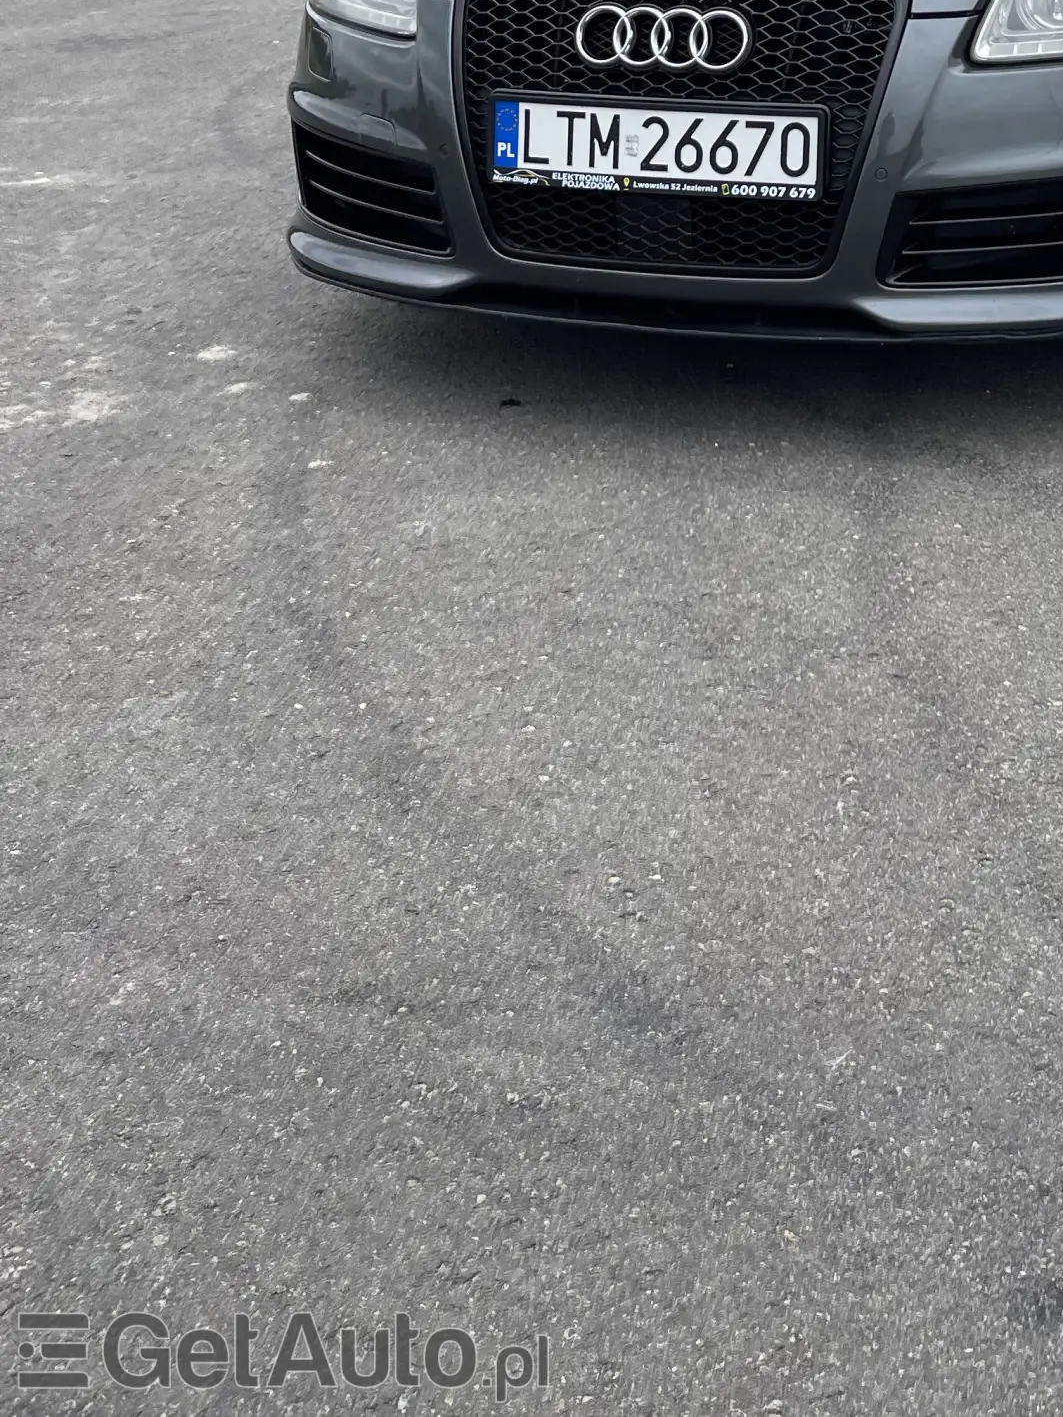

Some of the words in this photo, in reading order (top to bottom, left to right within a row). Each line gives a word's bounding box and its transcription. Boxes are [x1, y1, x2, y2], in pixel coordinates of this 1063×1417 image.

[523, 108, 621, 170] LTM
[640, 116, 811, 178] 26670
[497, 142, 515, 159] PL
[552, 172, 616, 183] ELEKTRONIKA
[562, 180, 620, 191] POJAZDOWA
[633, 180, 670, 190] Lwowska
[670, 183, 681, 191] 52
[731, 184, 758, 196] 600
[760, 185, 787, 198] 907
[789, 187, 817, 199] 679
